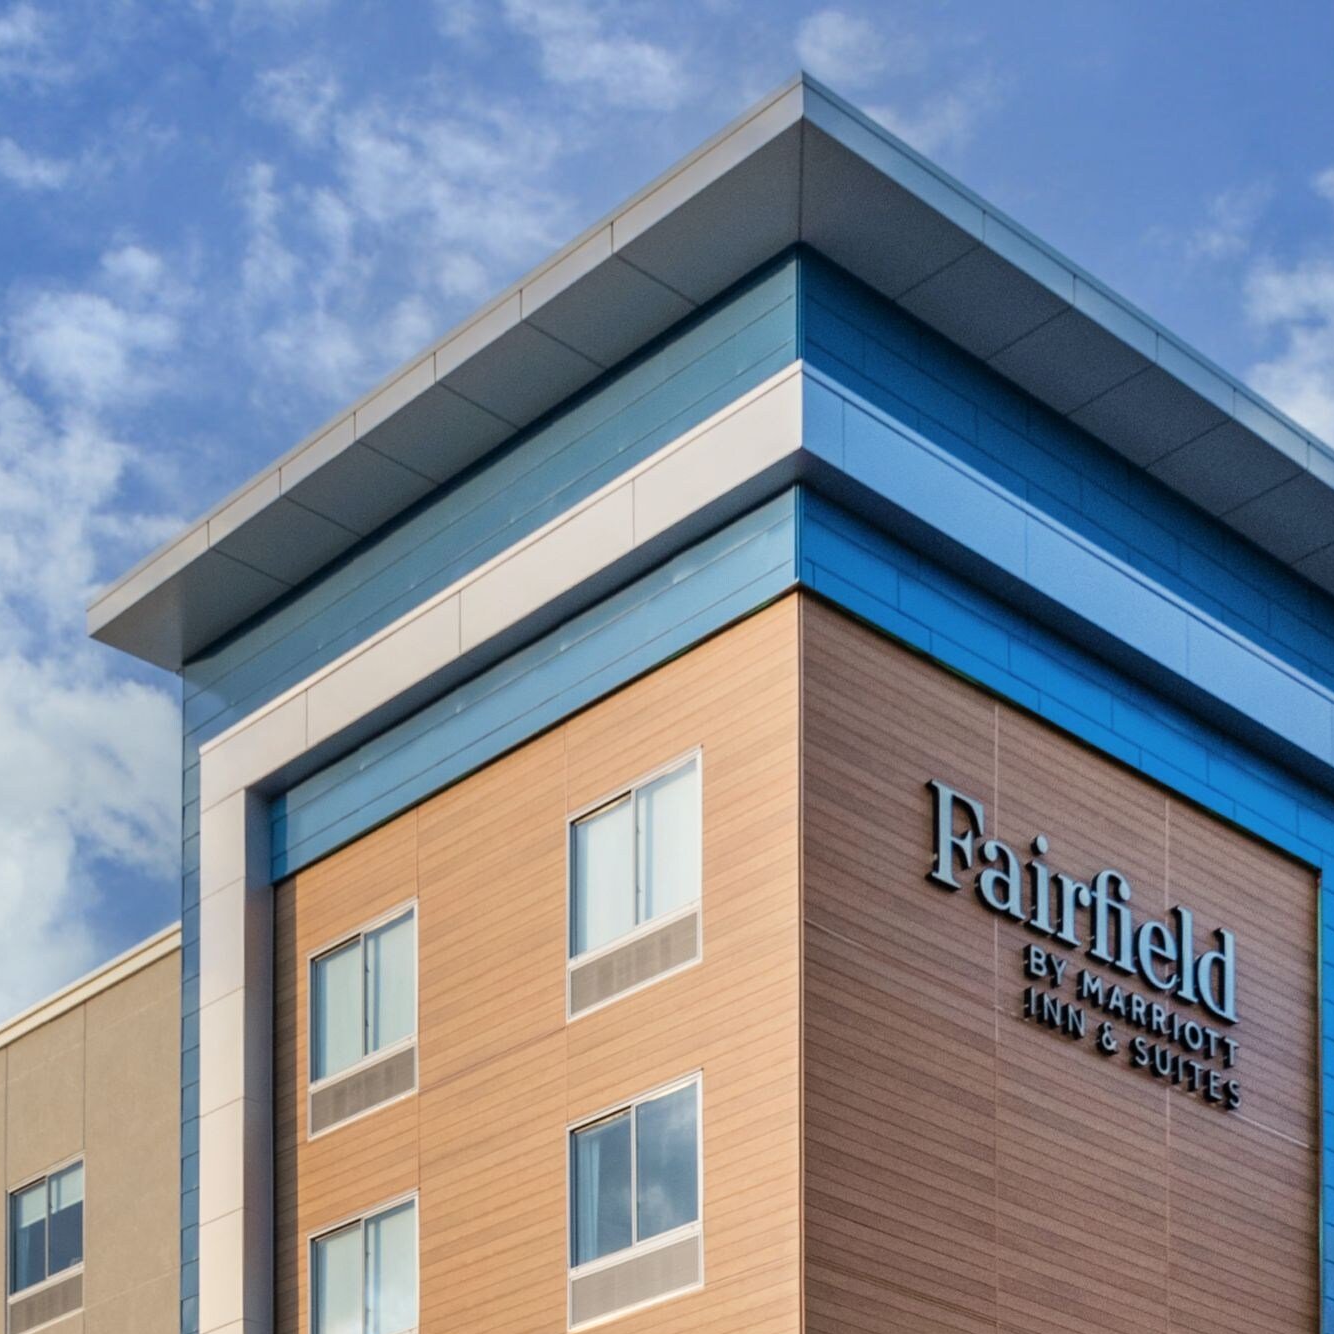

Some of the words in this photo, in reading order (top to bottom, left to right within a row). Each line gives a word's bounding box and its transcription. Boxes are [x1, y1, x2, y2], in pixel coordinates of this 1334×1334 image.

[925, 778, 1241, 1025] Fairfield
[1024, 942, 1067, 987] BY
[1077, 969, 1240, 1068] MARRIOTT
[1024, 986, 1087, 1038] INN
[1096, 1020, 1119, 1055] &
[1130, 1035, 1242, 1111] SUITES
